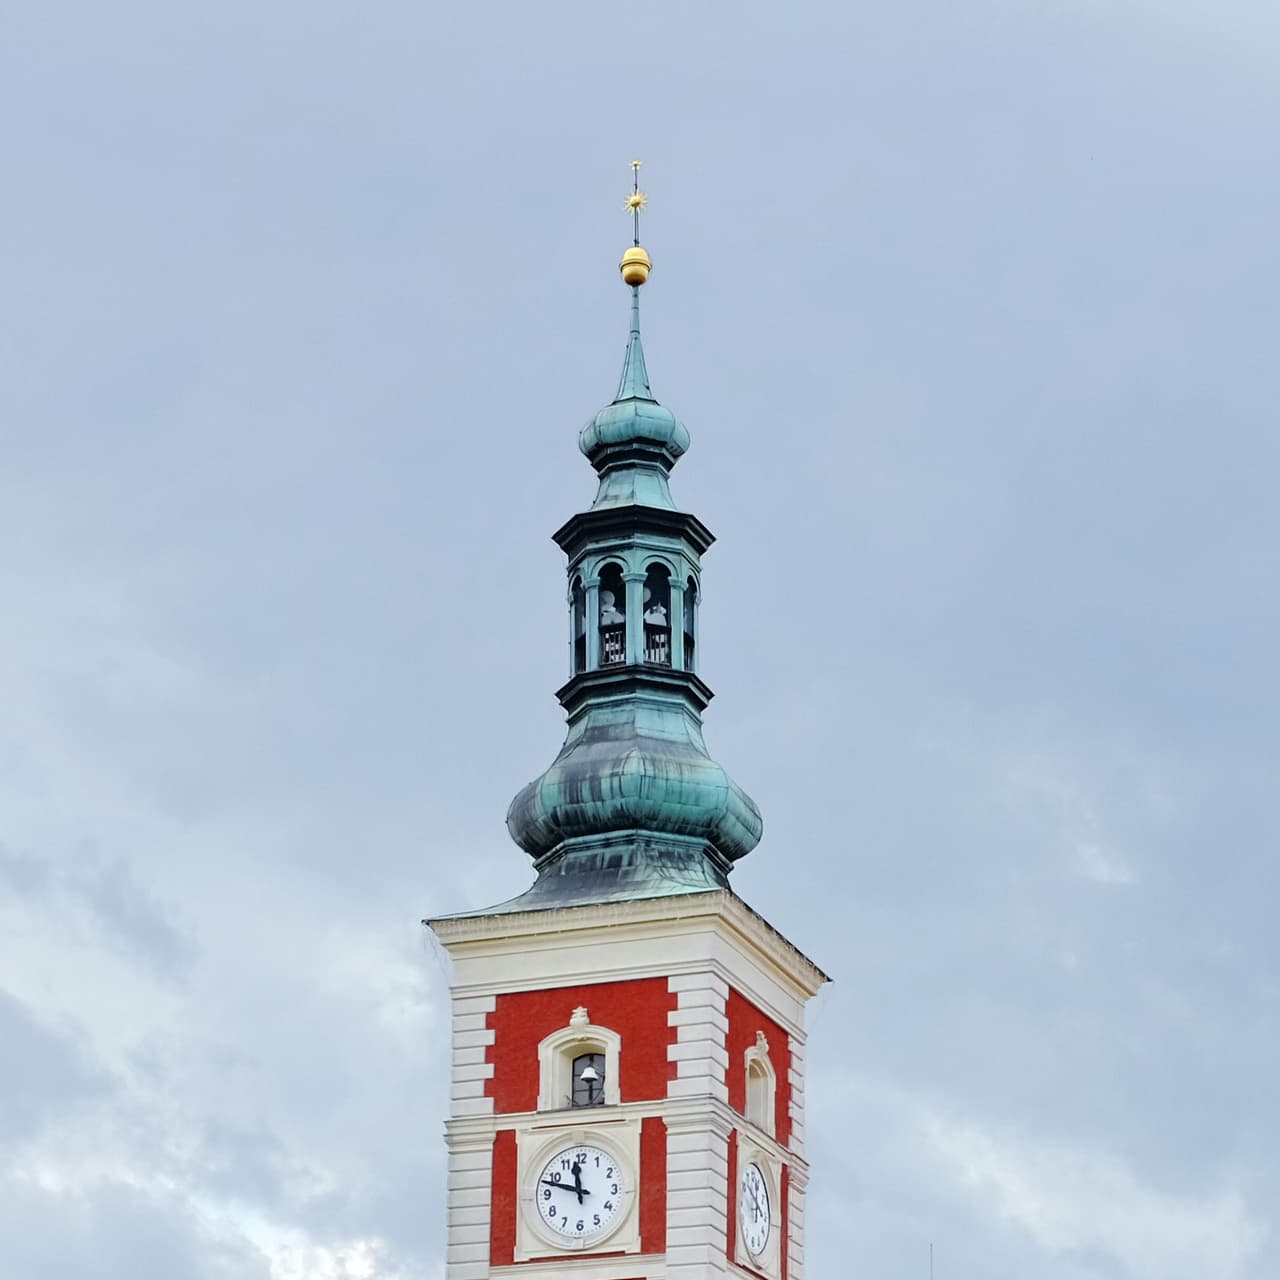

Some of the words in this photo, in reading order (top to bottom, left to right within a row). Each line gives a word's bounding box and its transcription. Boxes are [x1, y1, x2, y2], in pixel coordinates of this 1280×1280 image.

[576, 1153, 587, 1164] 12
[594, 1156, 600, 1168] 1
[561, 1159, 570, 1170] 11
[549, 1172, 561, 1183] 10
[606, 1167, 613, 1179] 2
[543, 1189, 552, 1200] 9
[610, 1183, 618, 1195] 3
[548, 1205, 556, 1217] 8
[603, 1200, 612, 1211] 4
[561, 1216, 568, 1228] 7
[576, 1219, 584, 1231] 6
[593, 1214, 600, 1225] 5
